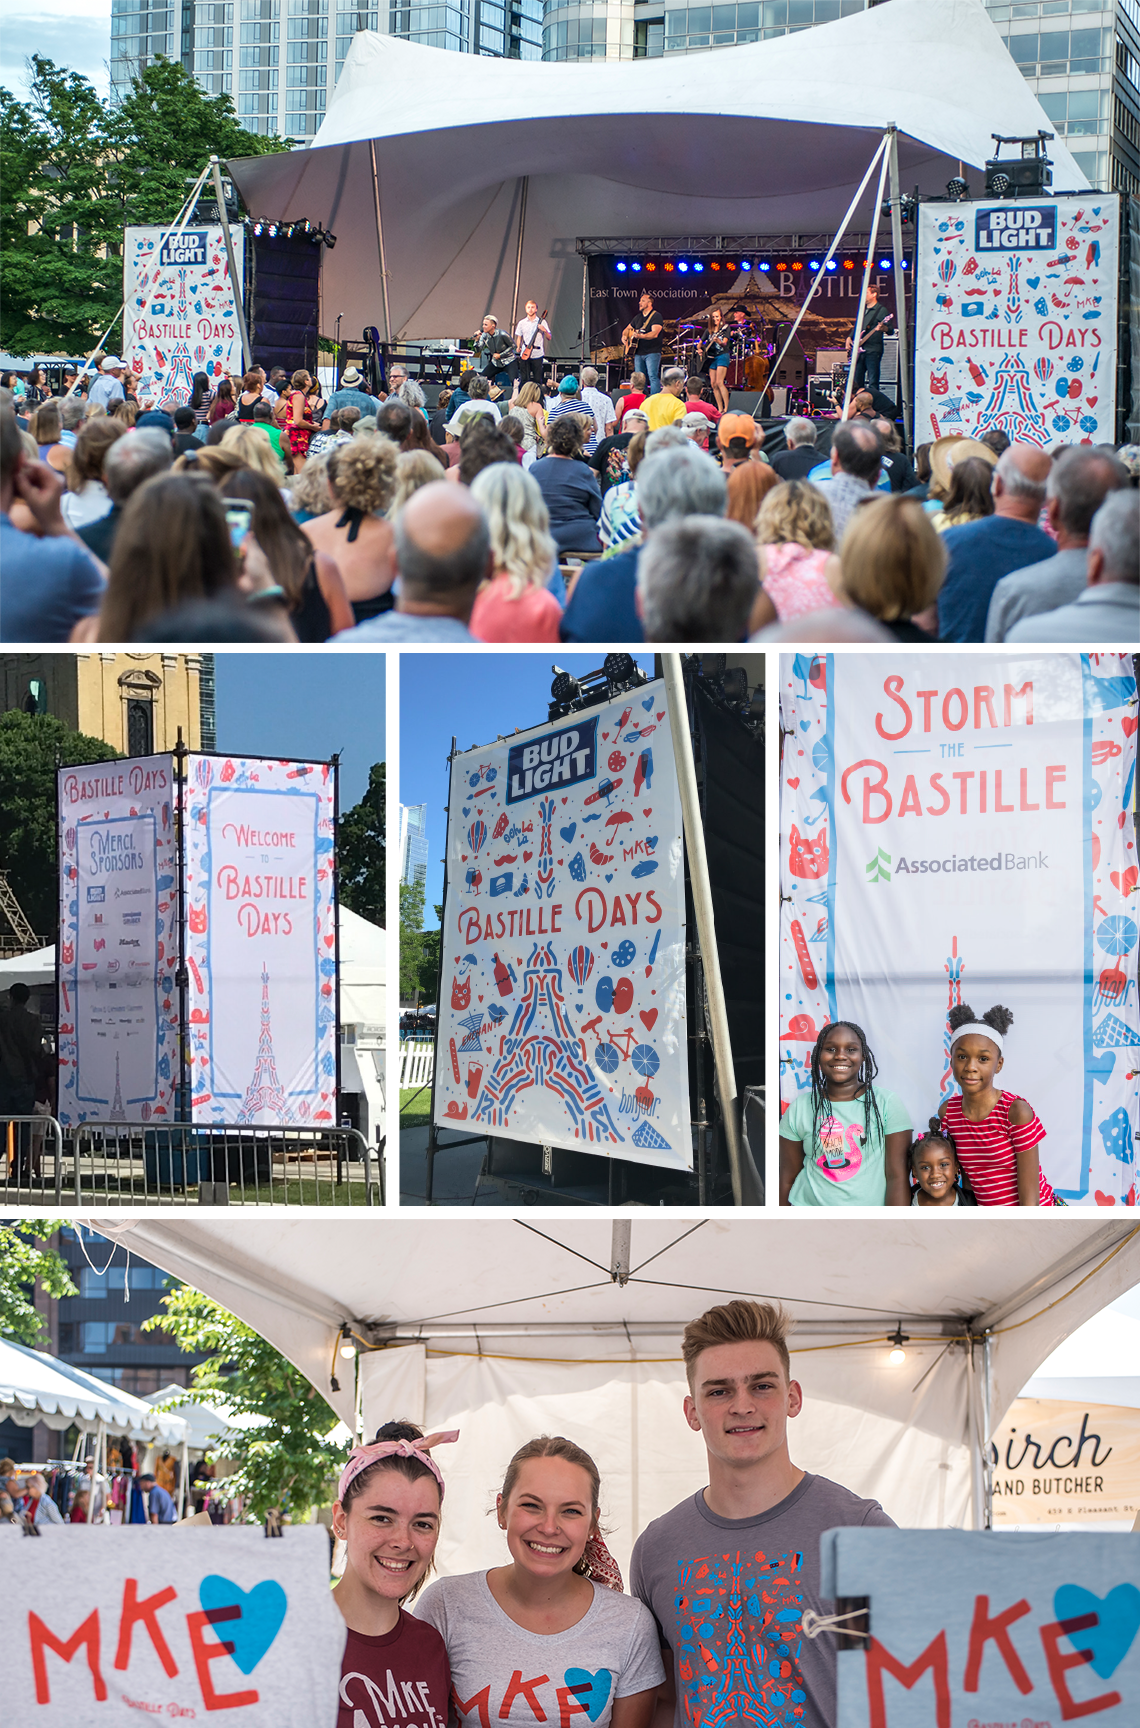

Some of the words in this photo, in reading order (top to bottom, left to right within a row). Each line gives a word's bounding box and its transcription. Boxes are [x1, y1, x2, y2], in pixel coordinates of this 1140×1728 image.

[989, 211, 1042, 229] BUD
[169, 235, 199, 249] BUD
[979, 228, 1051, 247] LIGHT
[162, 249, 204, 262] LIGHT
[590, 287, 609, 298] East
[611, 287, 639, 298] Town
[641, 287, 698, 299] Association
[1077, 296, 1100, 309] MKE
[133, 319, 192, 340] BASTILLE
[197, 318, 235, 340] DAYS
[931, 321, 1028, 350] BASTILLE
[1039, 320, 1102, 350] DAYS
[875, 675, 1034, 741] STORM
[522, 730, 580, 771] BUD
[939, 742, 965, 759] THE
[511, 748, 591, 797] LIGHT
[64, 775, 124, 803] BASTILLE
[129, 766, 168, 795] DAYS
[841, 758, 1067, 824] BASTILLE
[222, 823, 296, 848] WELCOME
[261, 854, 269, 863] TO
[623, 840, 655, 862] MKE
[90, 852, 144, 875] SPONSORS
[217, 865, 307, 900] BASTILLE
[237, 902, 293, 937] DAYS
[458, 903, 563, 945] BASTILLE
[575, 887, 662, 934] DAYS
[992, 1480, 1025, 1496] AND
[1032, 1476, 1104, 1495] BUTCHER
[1078, 1506, 1119, 1514] Pleasant
[28, 1577, 260, 1712] MKE
[338, 1669, 436, 1724] MKE
